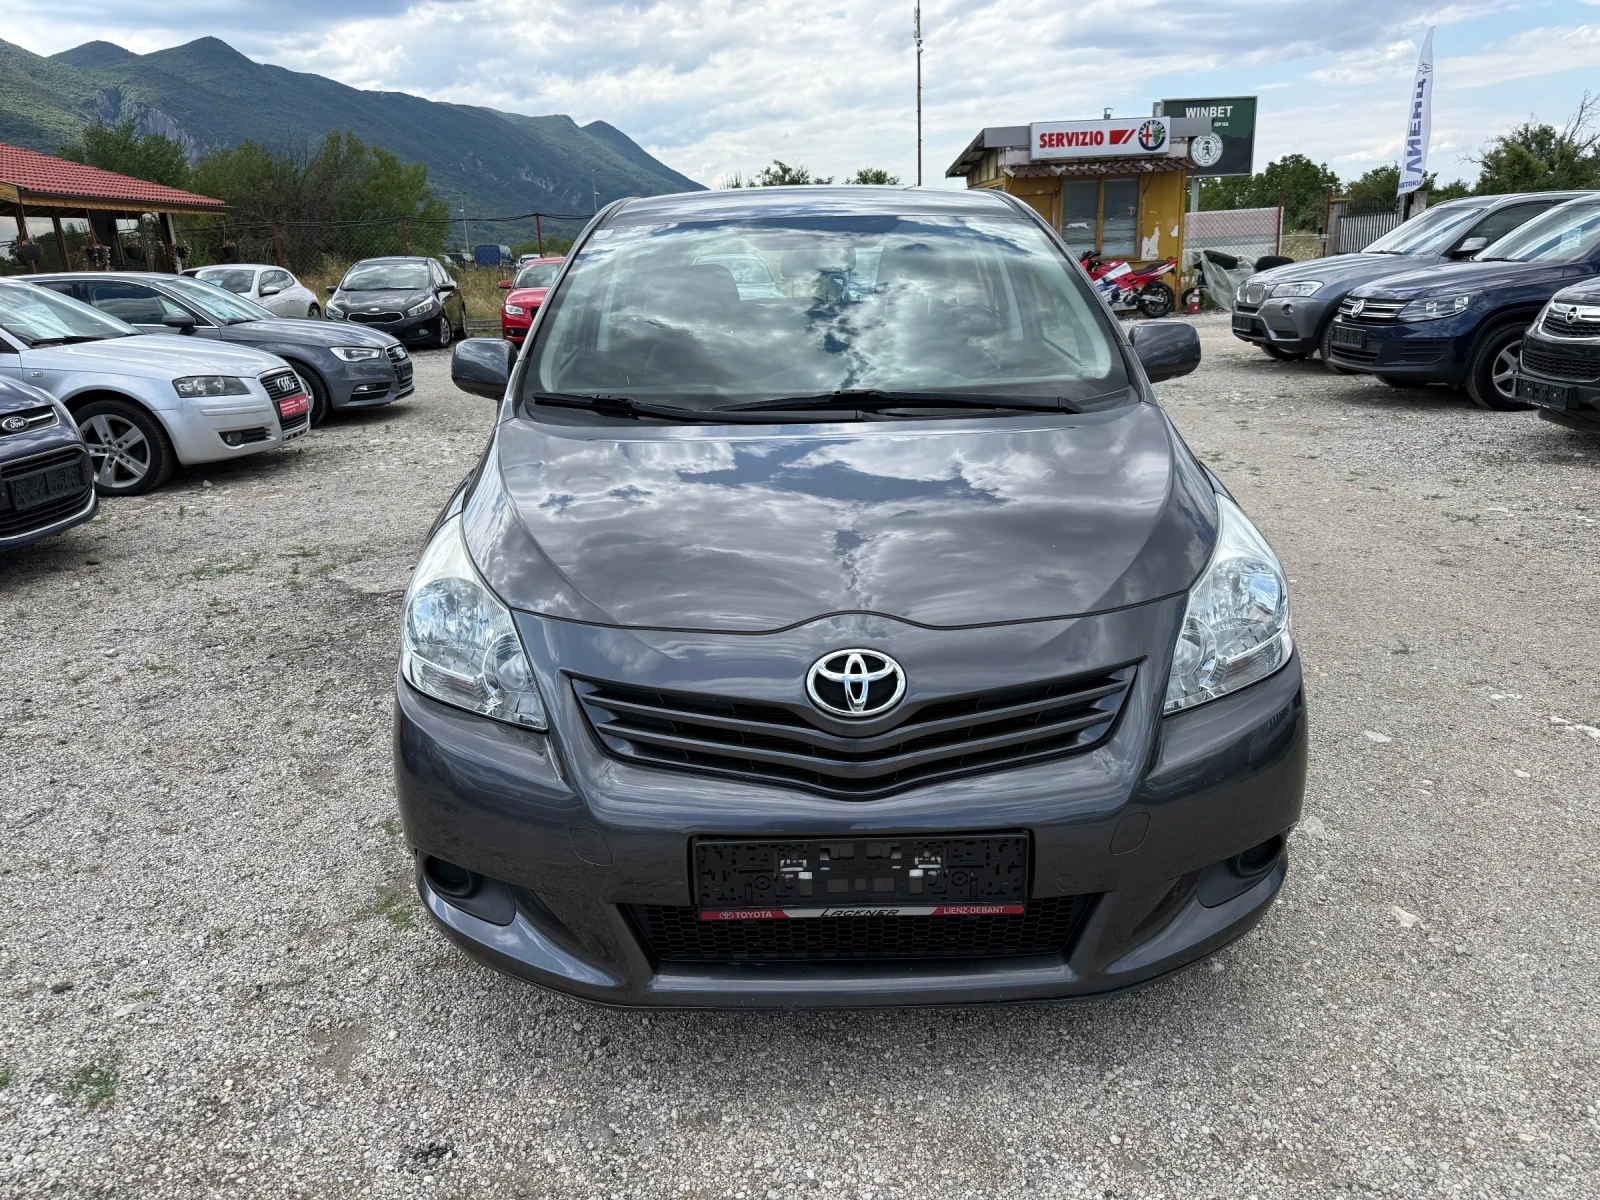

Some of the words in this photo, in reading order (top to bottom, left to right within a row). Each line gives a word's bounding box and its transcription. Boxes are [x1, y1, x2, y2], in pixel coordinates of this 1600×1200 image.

[1185, 106, 1233, 118] WINBET
[1039, 130, 1104, 148] SERVIZIO
[943, 906, 1004, 914] LIENZ-DEBANT
